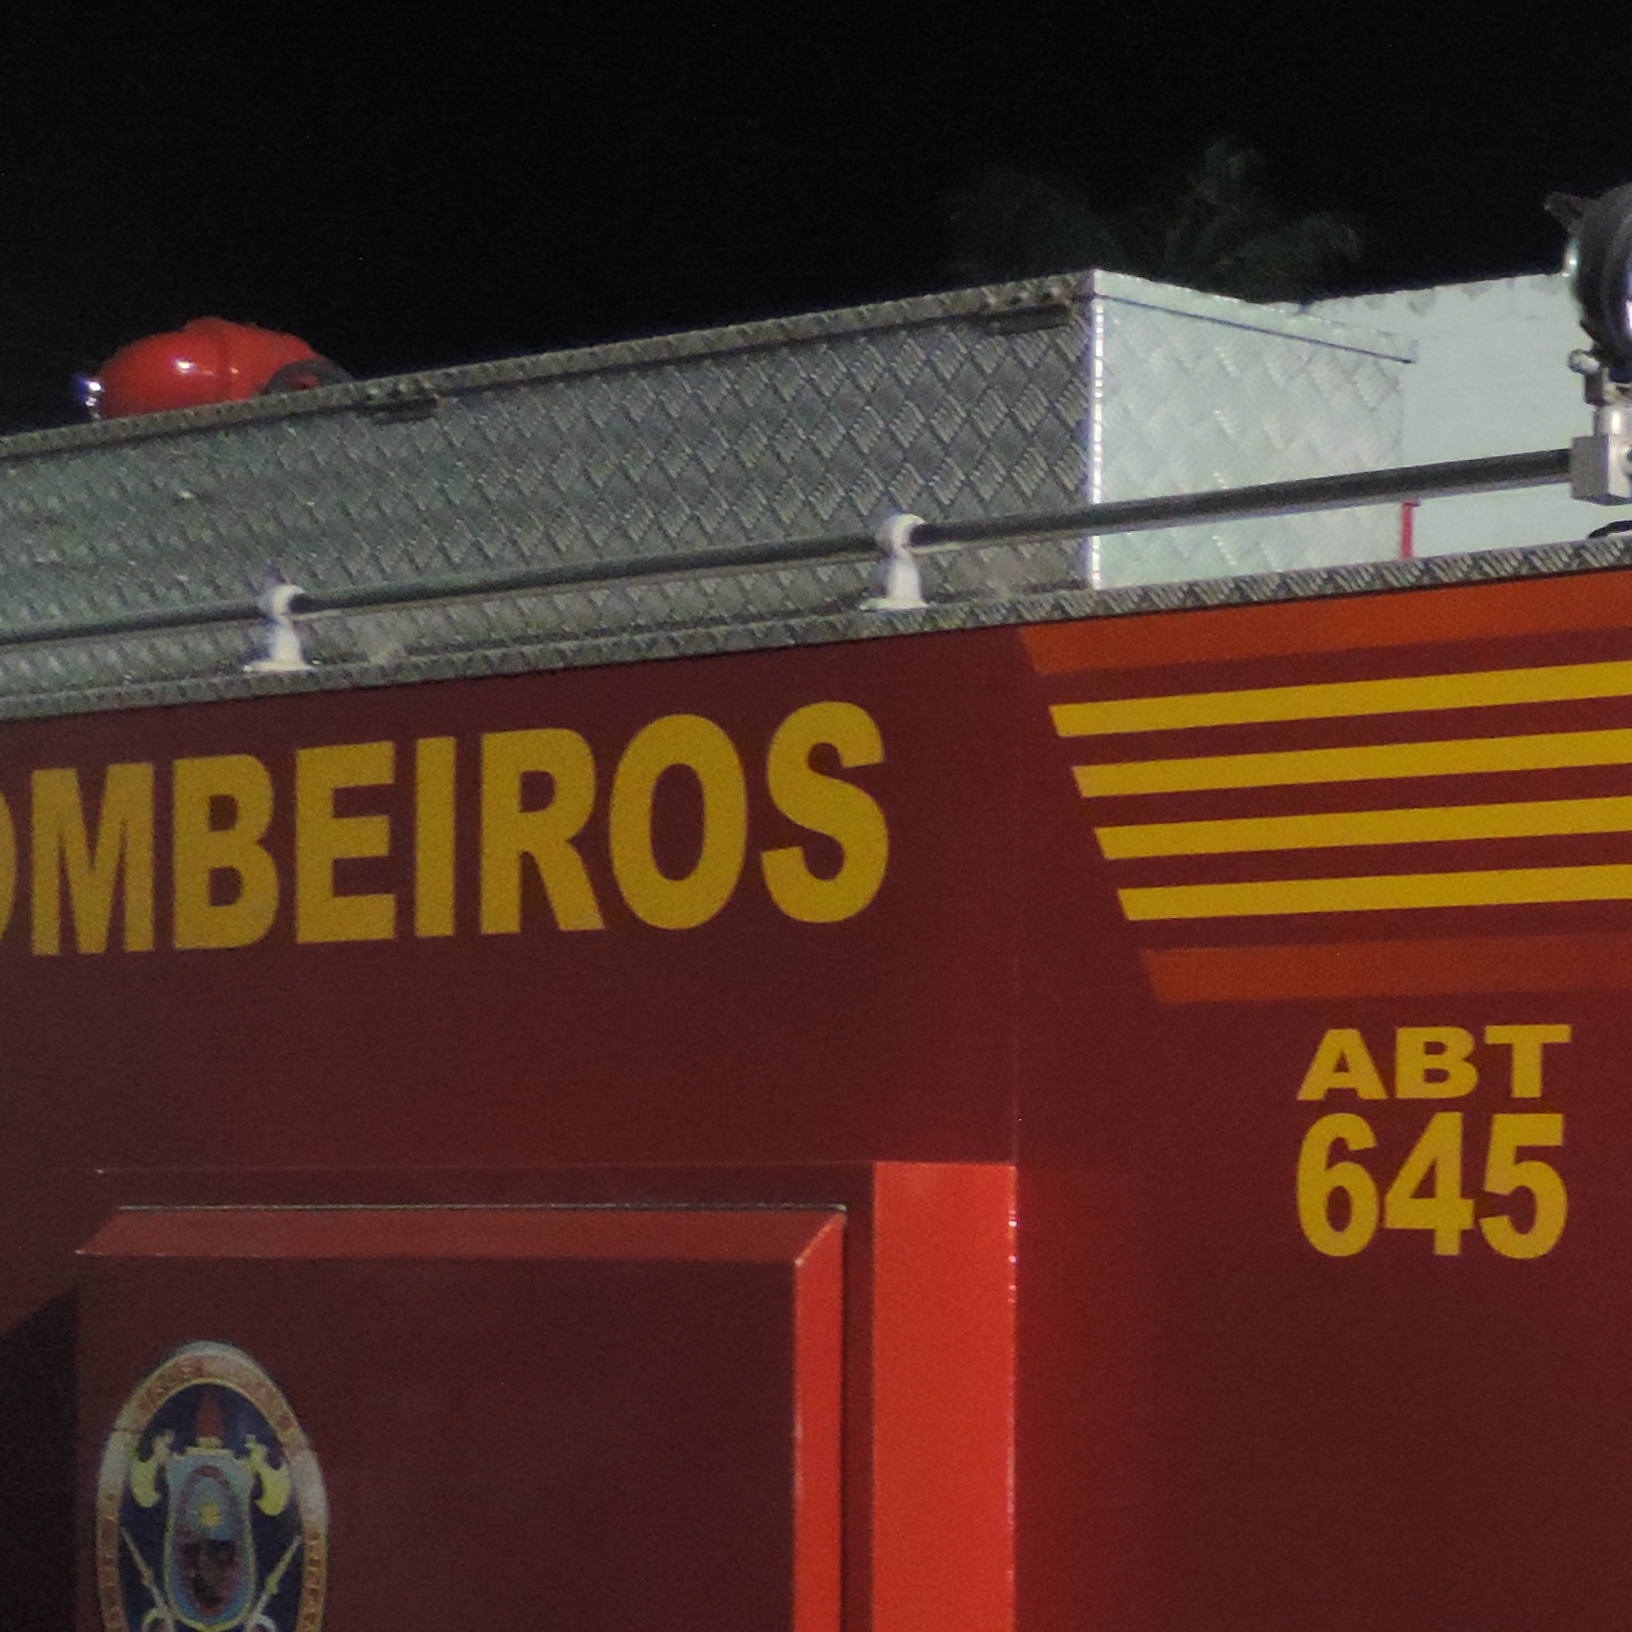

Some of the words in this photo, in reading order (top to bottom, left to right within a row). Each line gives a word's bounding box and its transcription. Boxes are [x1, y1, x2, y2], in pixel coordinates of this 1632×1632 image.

[0, 700, 890, 957] MBEIROS
[1297, 1024, 1571, 1100] ABT
[1297, 1112, 1568, 1259] 645
